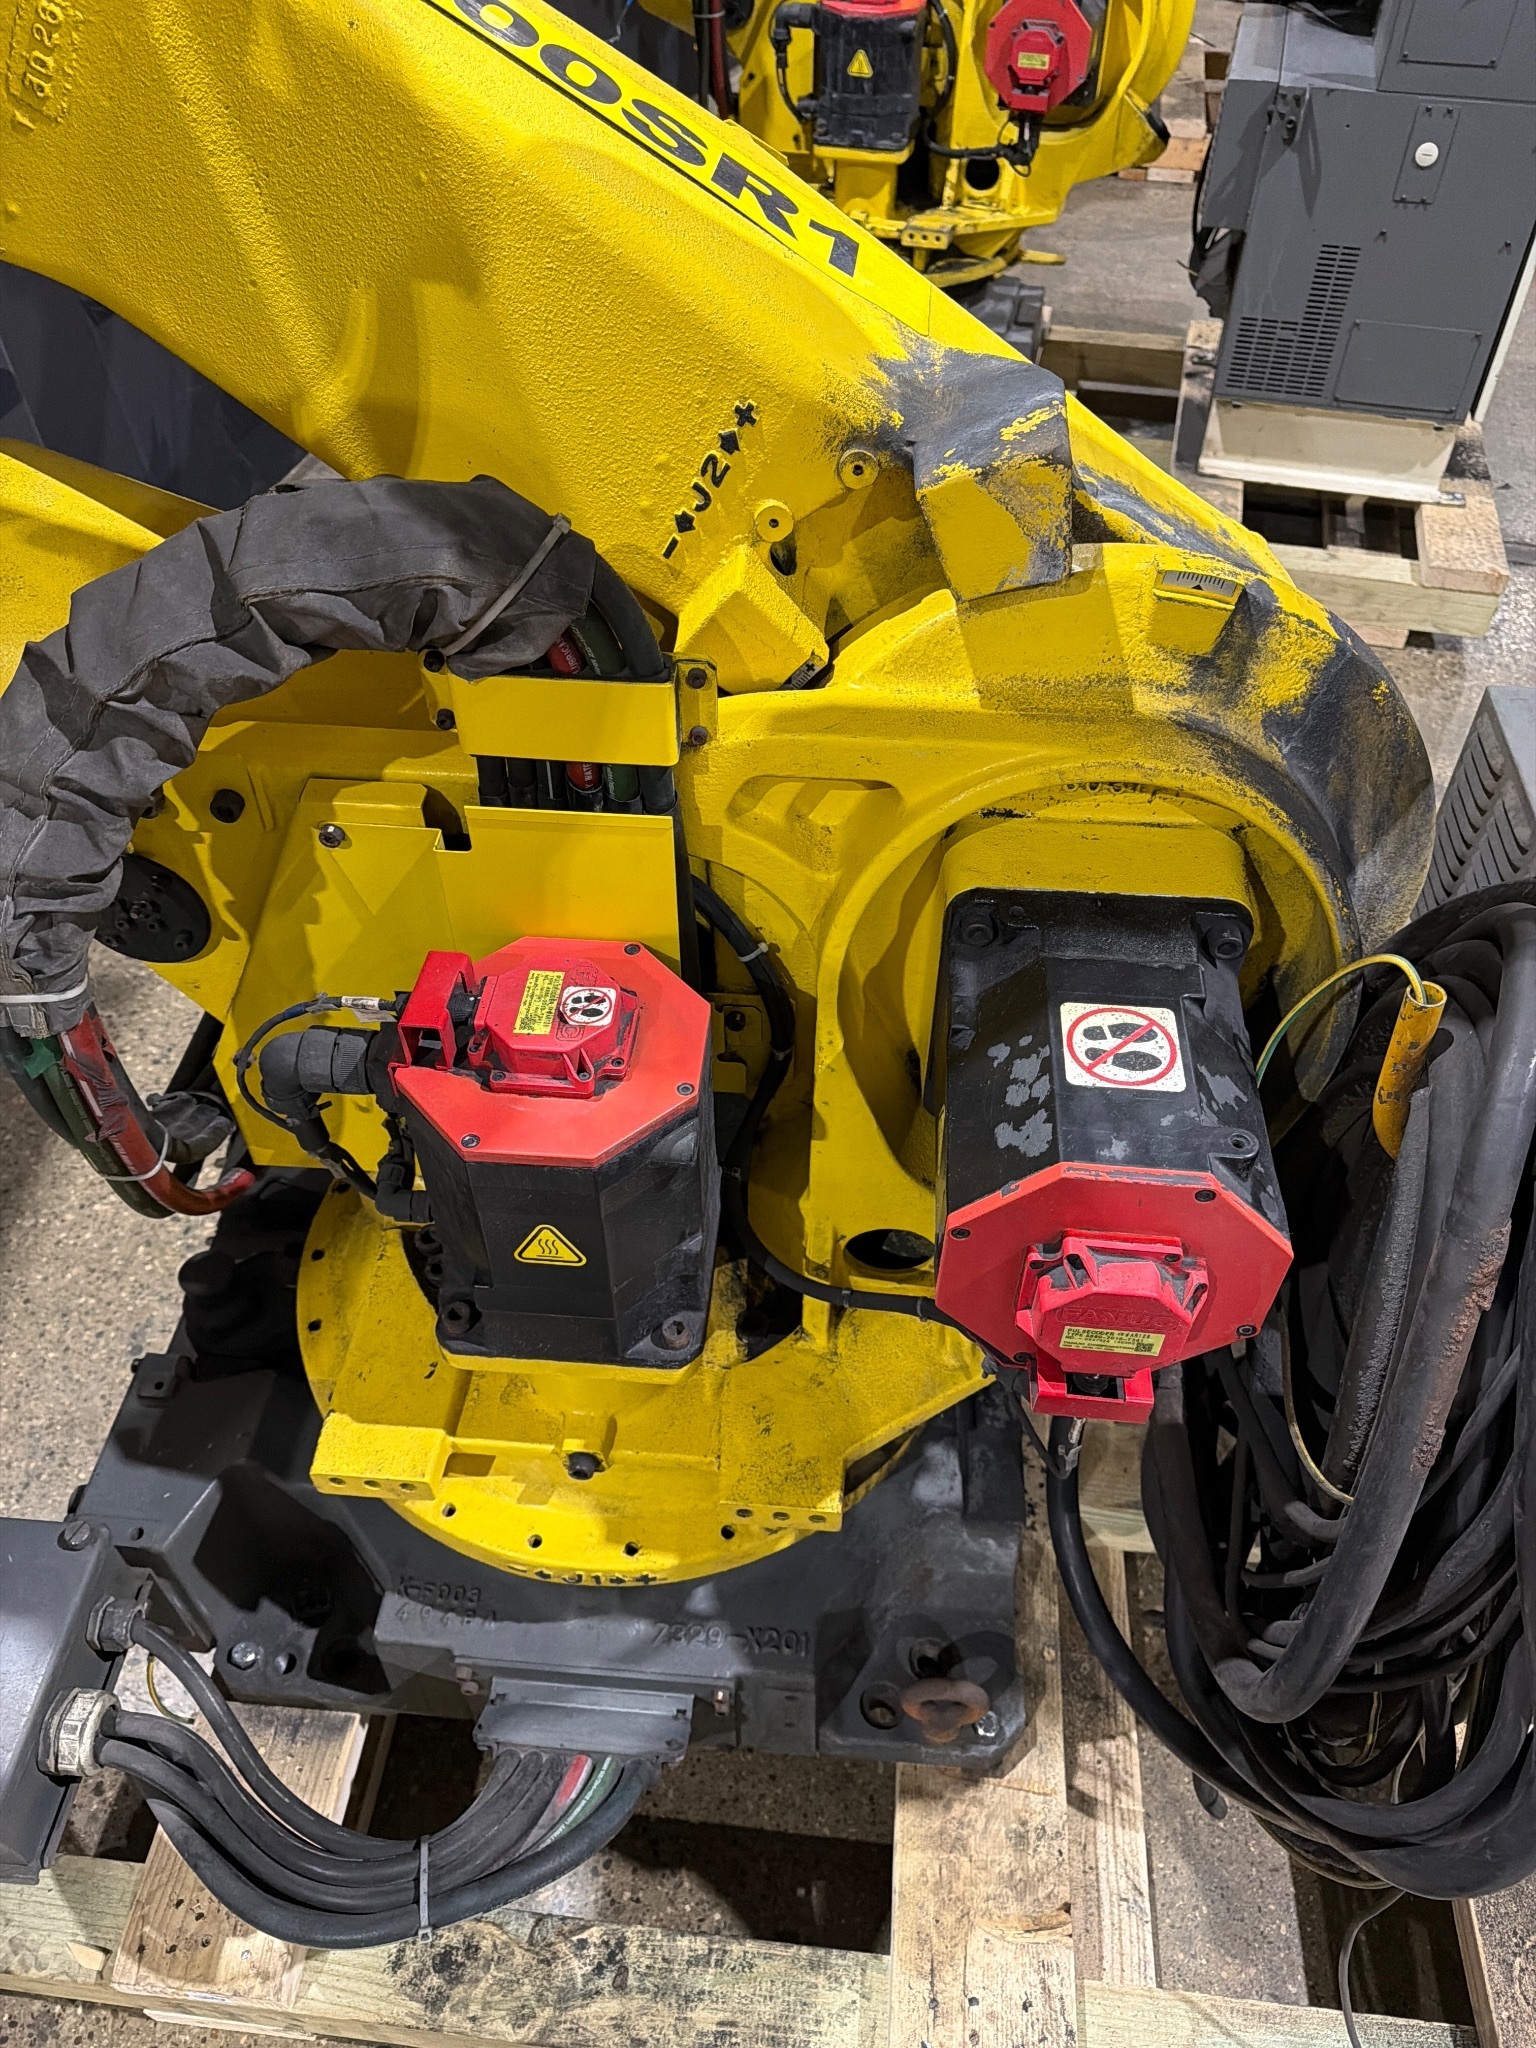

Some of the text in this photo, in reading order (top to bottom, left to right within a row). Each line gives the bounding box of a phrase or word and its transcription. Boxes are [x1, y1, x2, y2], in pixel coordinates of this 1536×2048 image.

[691, 452, 732, 513] J2
[1058, 1308, 1178, 1331] FANUC
[1067, 1327, 1115, 1336] PULSECODER
